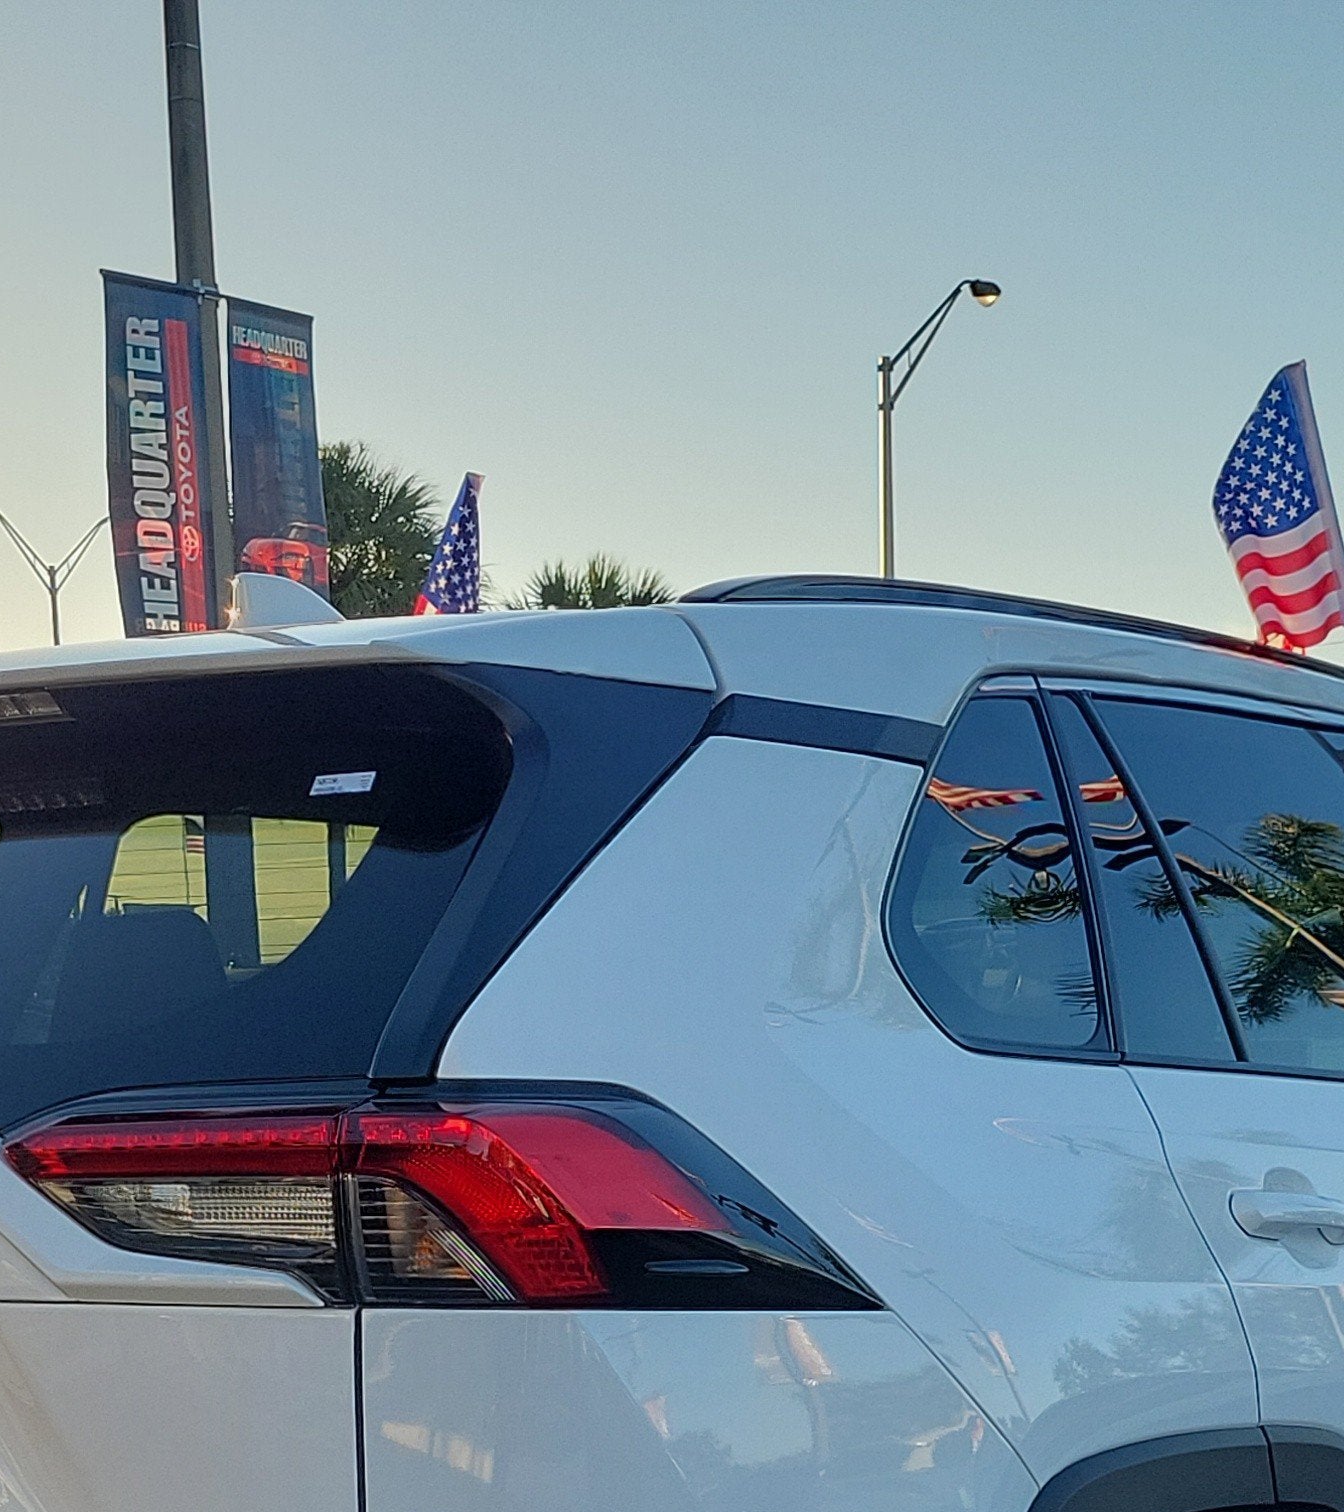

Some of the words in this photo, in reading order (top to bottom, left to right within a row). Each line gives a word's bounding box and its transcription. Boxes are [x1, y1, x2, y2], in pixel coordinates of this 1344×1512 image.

[232, 325, 308, 360] HEADQUARTER
[125, 316, 182, 632] HEADQUARTER
[174, 406, 197, 512] TOYOTA
